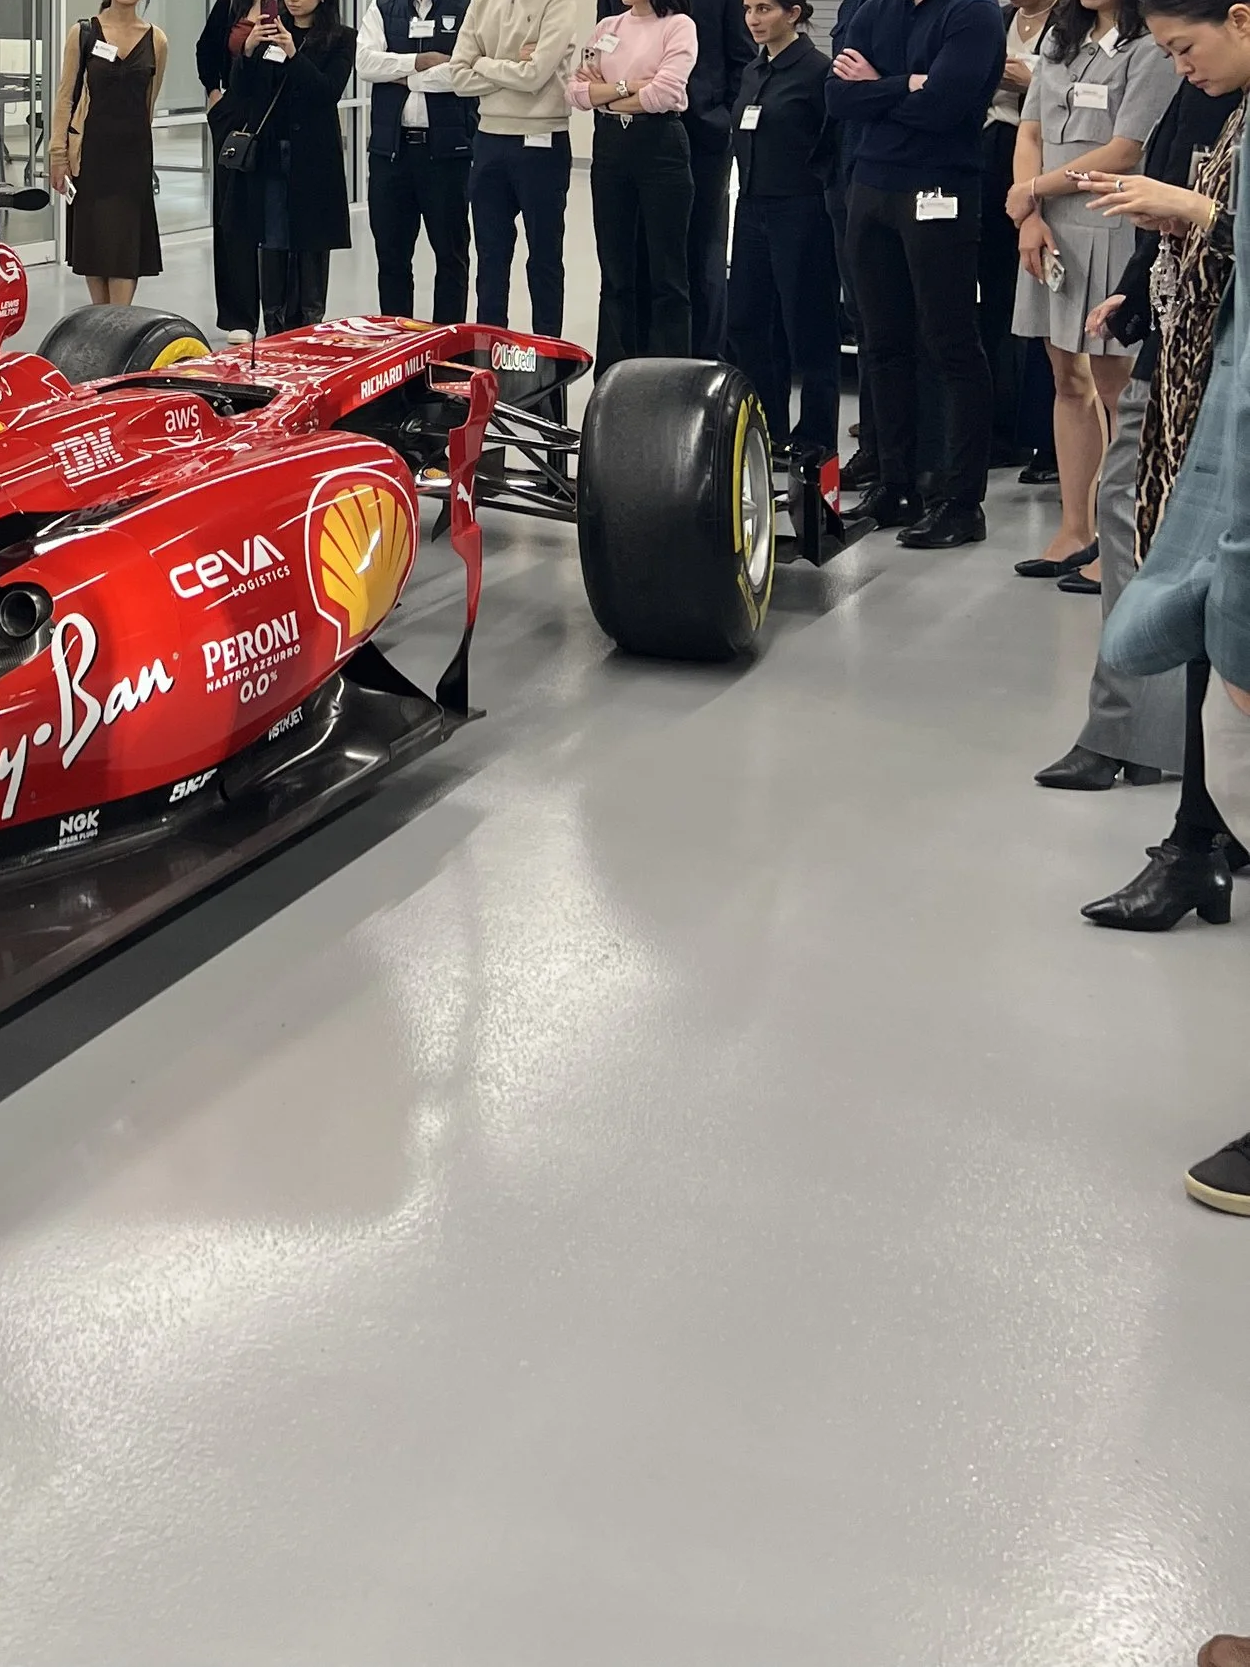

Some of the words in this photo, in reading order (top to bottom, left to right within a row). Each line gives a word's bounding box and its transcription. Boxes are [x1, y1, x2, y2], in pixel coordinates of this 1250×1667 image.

[0, 298, 20, 311] LEWIS
[501, 344, 537, 372] UniCredit
[360, 364, 403, 400] RICHARD
[165, 403, 199, 434] aws
[51, 426, 124, 480] IBM
[232, 564, 291, 597] LOGISTICS
[201, 610, 301, 679] PERONI
[206, 666, 250, 694] NASTRO
[252, 644, 301, 673] AZZURRO
[239, 671, 278, 704] 0.0%
[169, 768, 217, 803] SKF
[59, 808, 100, 837] NGK
